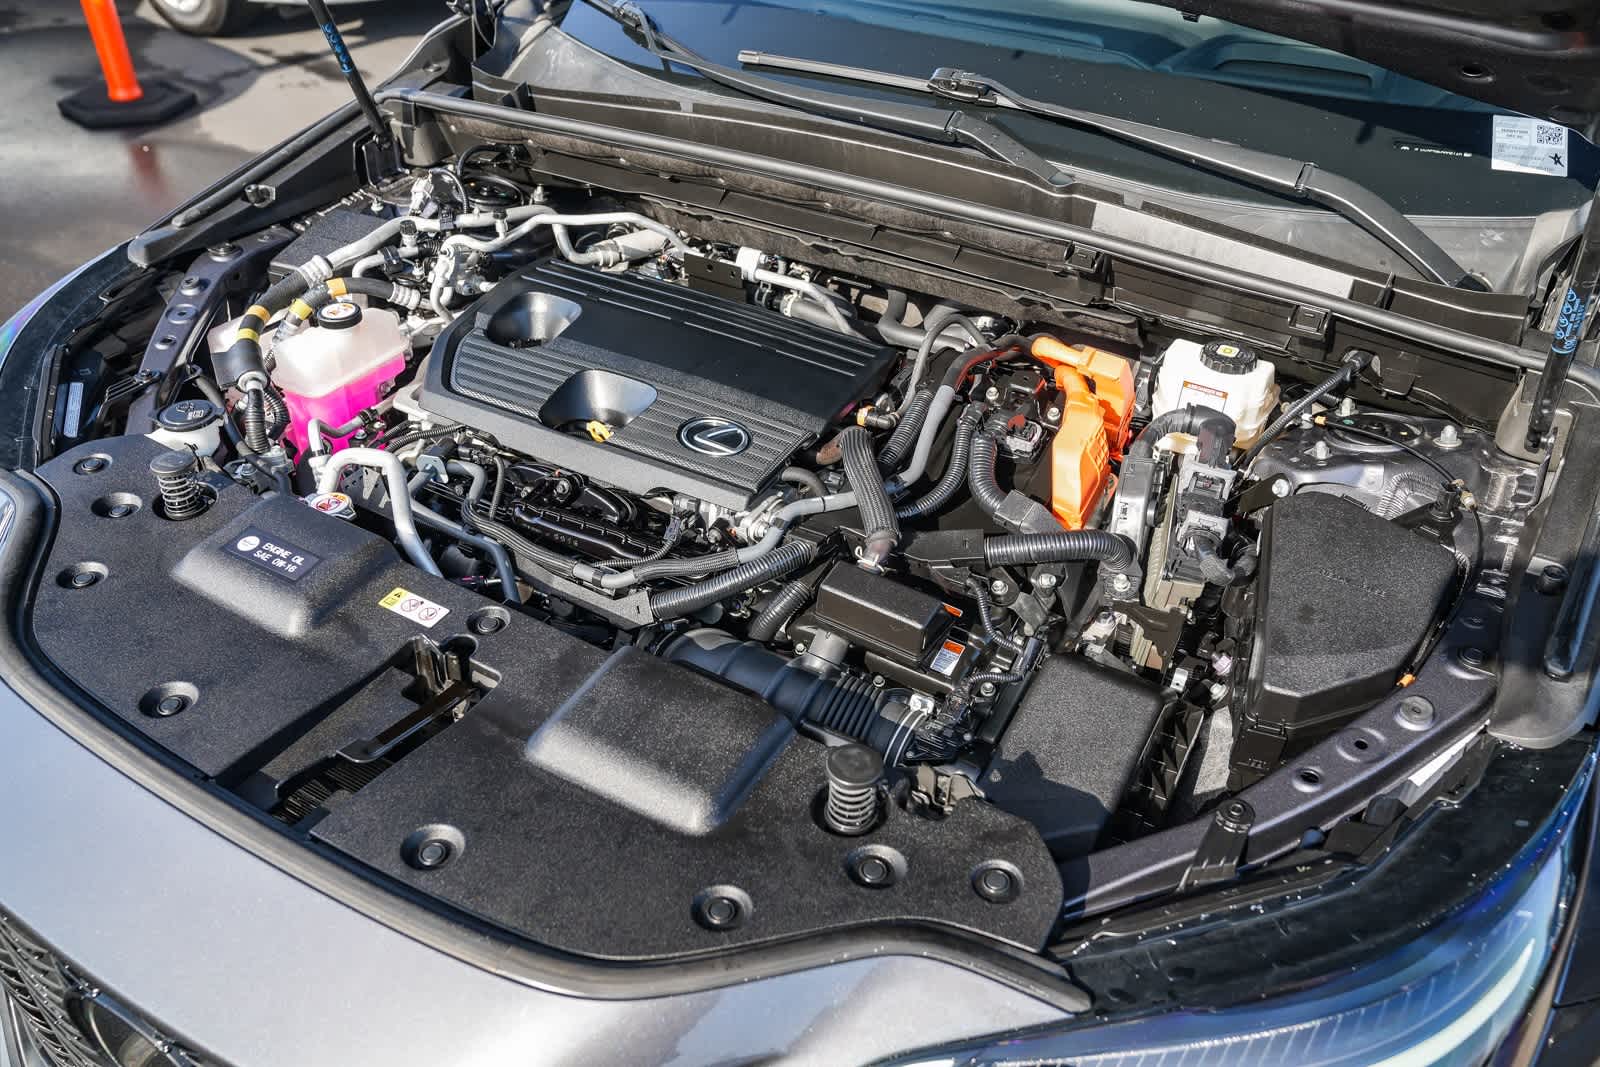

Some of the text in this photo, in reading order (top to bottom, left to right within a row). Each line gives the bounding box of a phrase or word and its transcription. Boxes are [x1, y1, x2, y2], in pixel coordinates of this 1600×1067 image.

[253, 550, 273, 562] SAE
[262, 542, 293, 559] ENGINE
[291, 555, 305, 566] OIL
